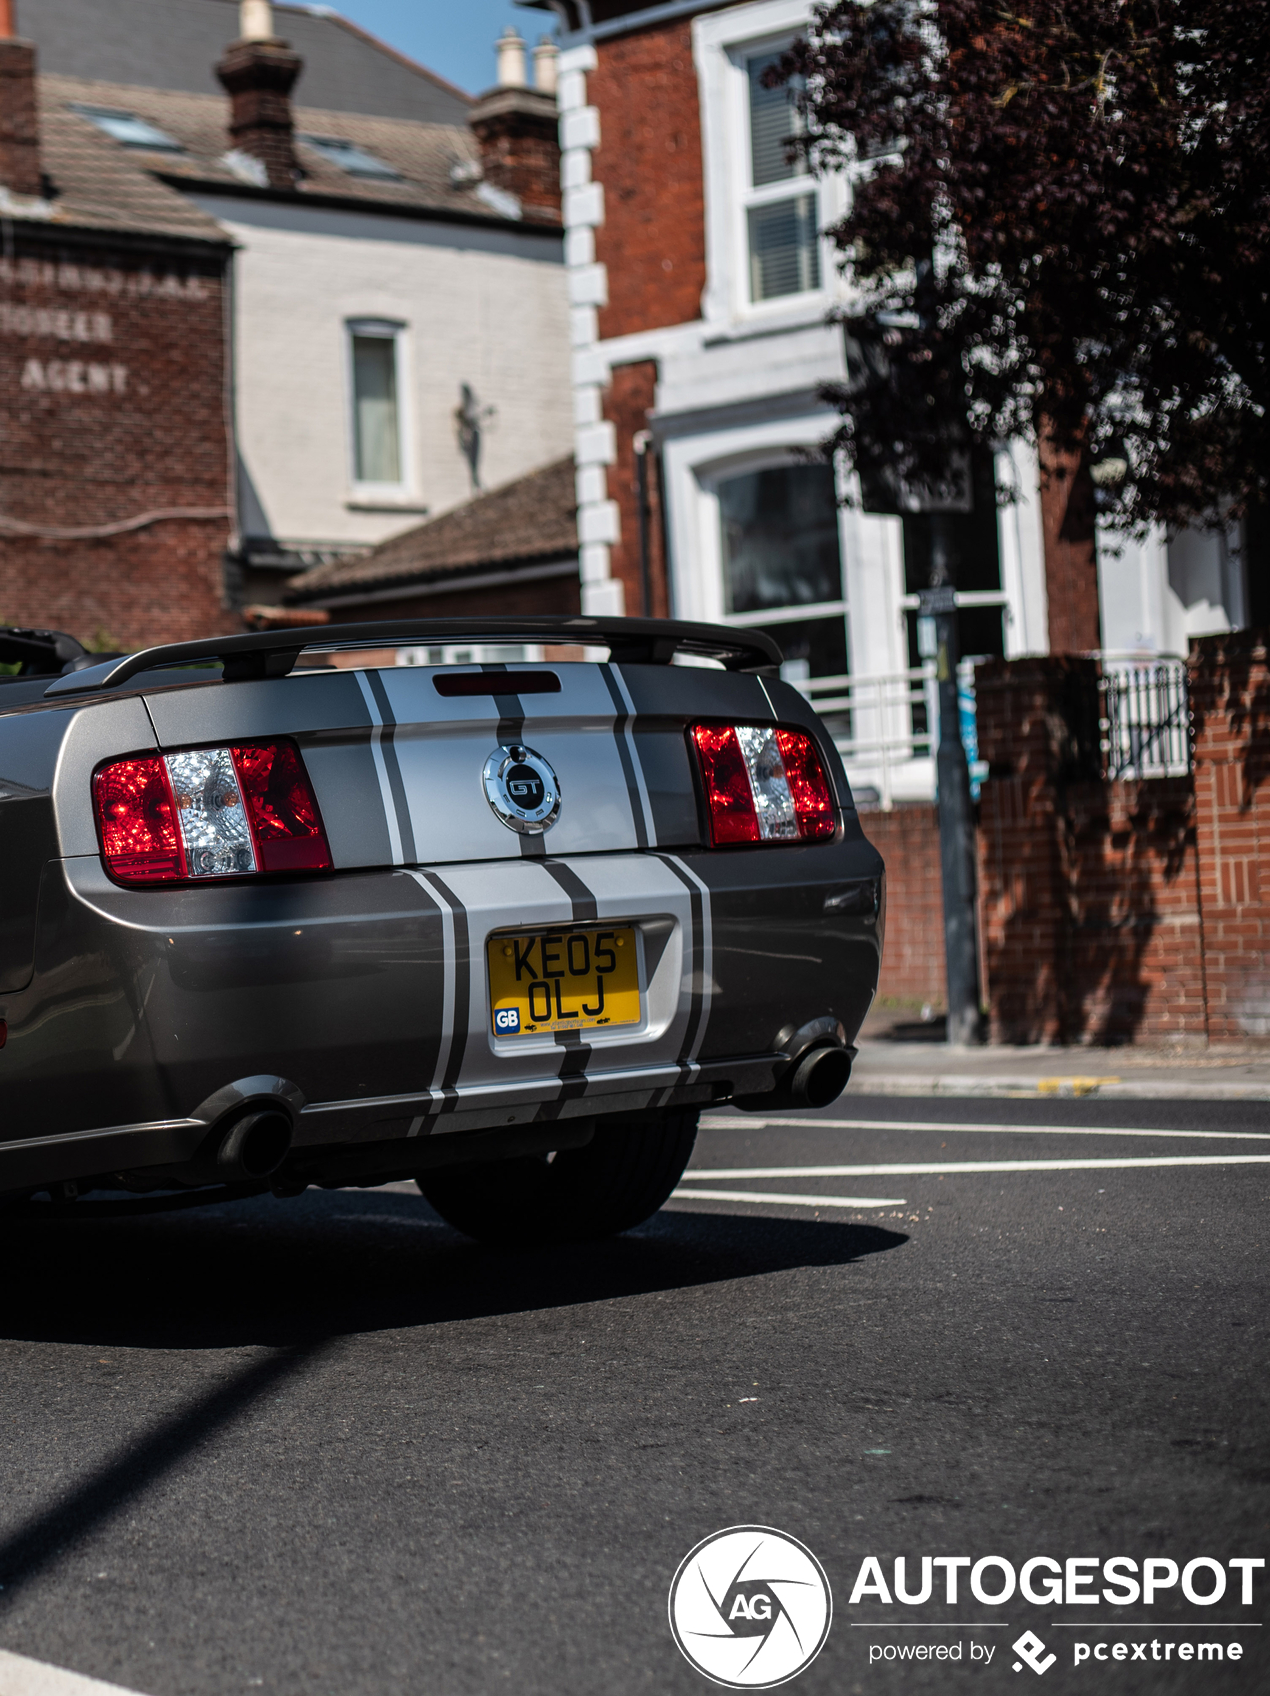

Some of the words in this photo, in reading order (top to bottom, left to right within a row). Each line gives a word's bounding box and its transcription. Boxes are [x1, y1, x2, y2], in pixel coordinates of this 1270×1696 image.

[510, 779, 540, 795] GT
[514, 932, 617, 981] KE05
[528, 975, 605, 1022] OLJ
[496, 1010, 519, 1028] GB
